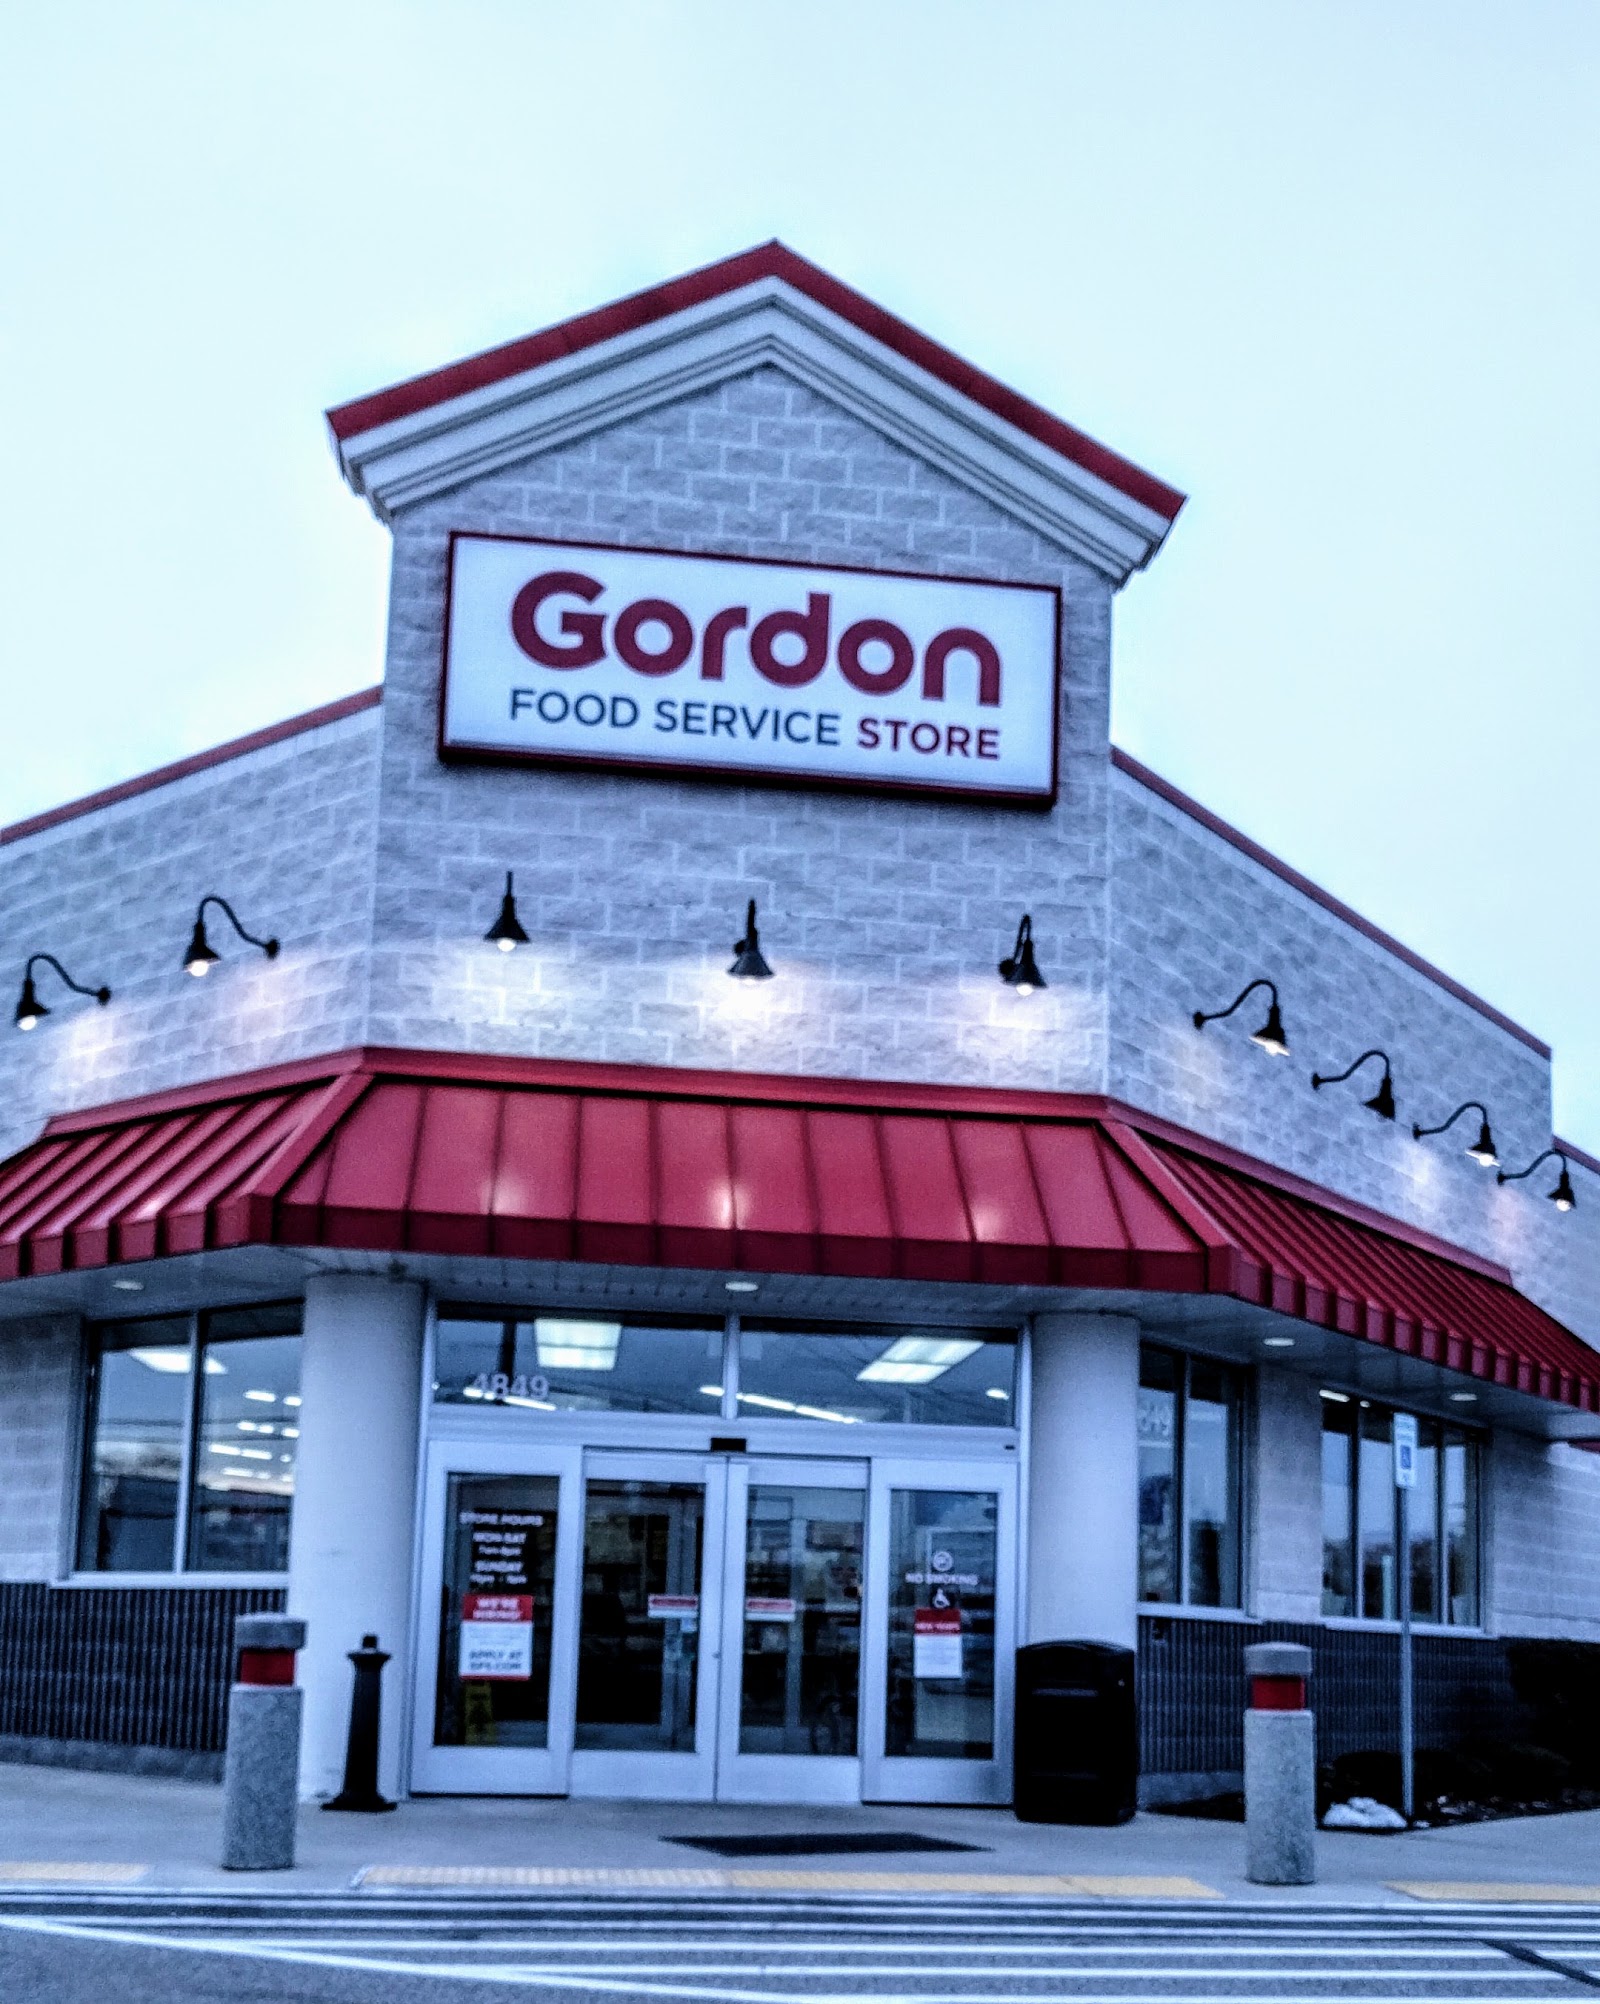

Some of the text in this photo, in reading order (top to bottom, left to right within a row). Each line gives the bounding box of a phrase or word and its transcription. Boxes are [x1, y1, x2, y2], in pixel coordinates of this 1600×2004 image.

[511, 570, 1002, 707] Gordon
[510, 687, 999, 760] FOOD SERVICE STORE
[473, 1373, 549, 1401] 4849
